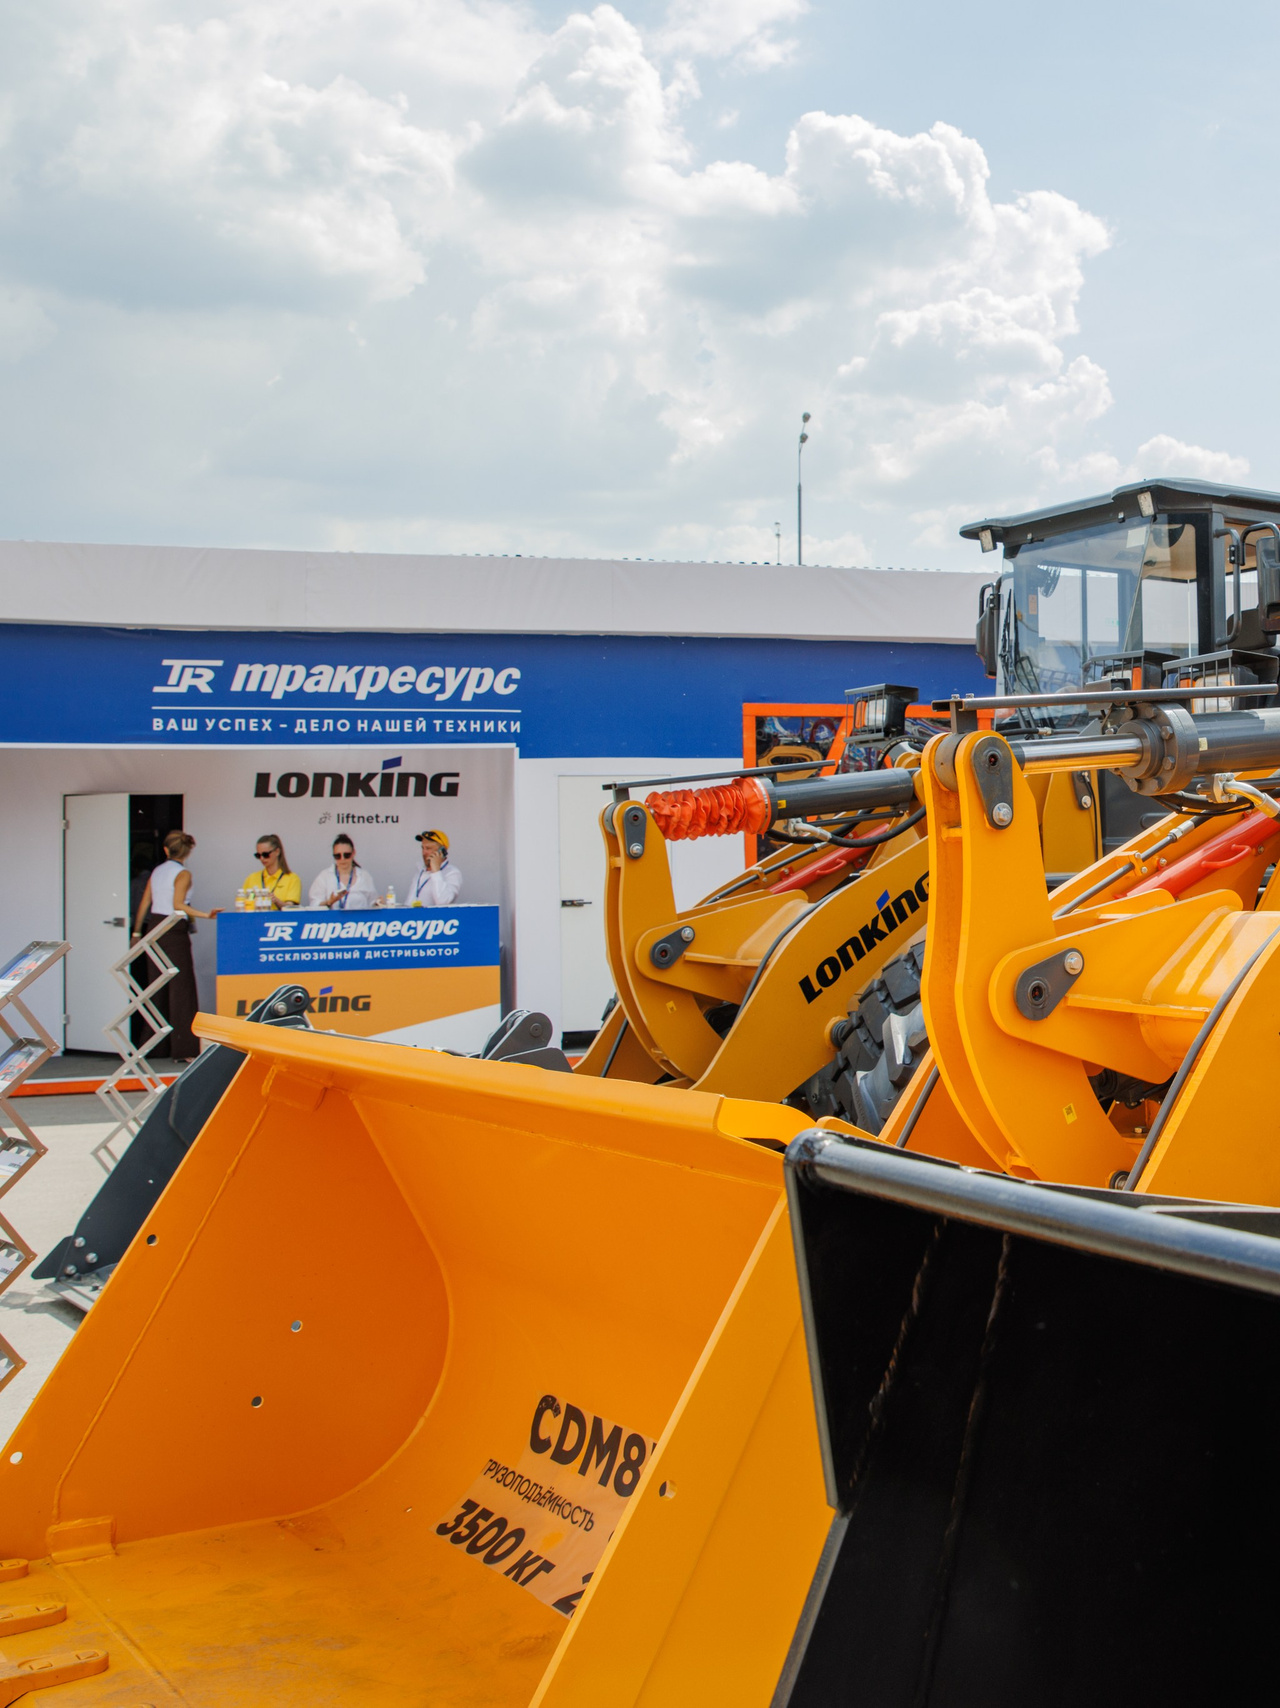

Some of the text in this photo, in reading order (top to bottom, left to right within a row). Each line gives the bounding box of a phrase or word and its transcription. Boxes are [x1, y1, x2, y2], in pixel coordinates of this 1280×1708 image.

[230, 662, 521, 702] тракресурс
[152, 718, 198, 731] ВАШ
[205, 718, 273, 731] УСПЕХ
[294, 719, 351, 734] ДЕЛО
[357, 717, 427, 733] НАШЕЙ
[433, 719, 521, 734] ТЕХНИКИ
[254, 756, 461, 798] LONKING
[336, 812, 400, 825] liftnet.ru
[301, 919, 459, 943] тракресурс
[259, 948, 460, 962] ЭКСКЛЮЗИВНЫЙ ДИСТРИБЬЮТОР
[529, 1395, 657, 1498] CDM8
[435, 1498, 556, 1587] 3500 КГ
